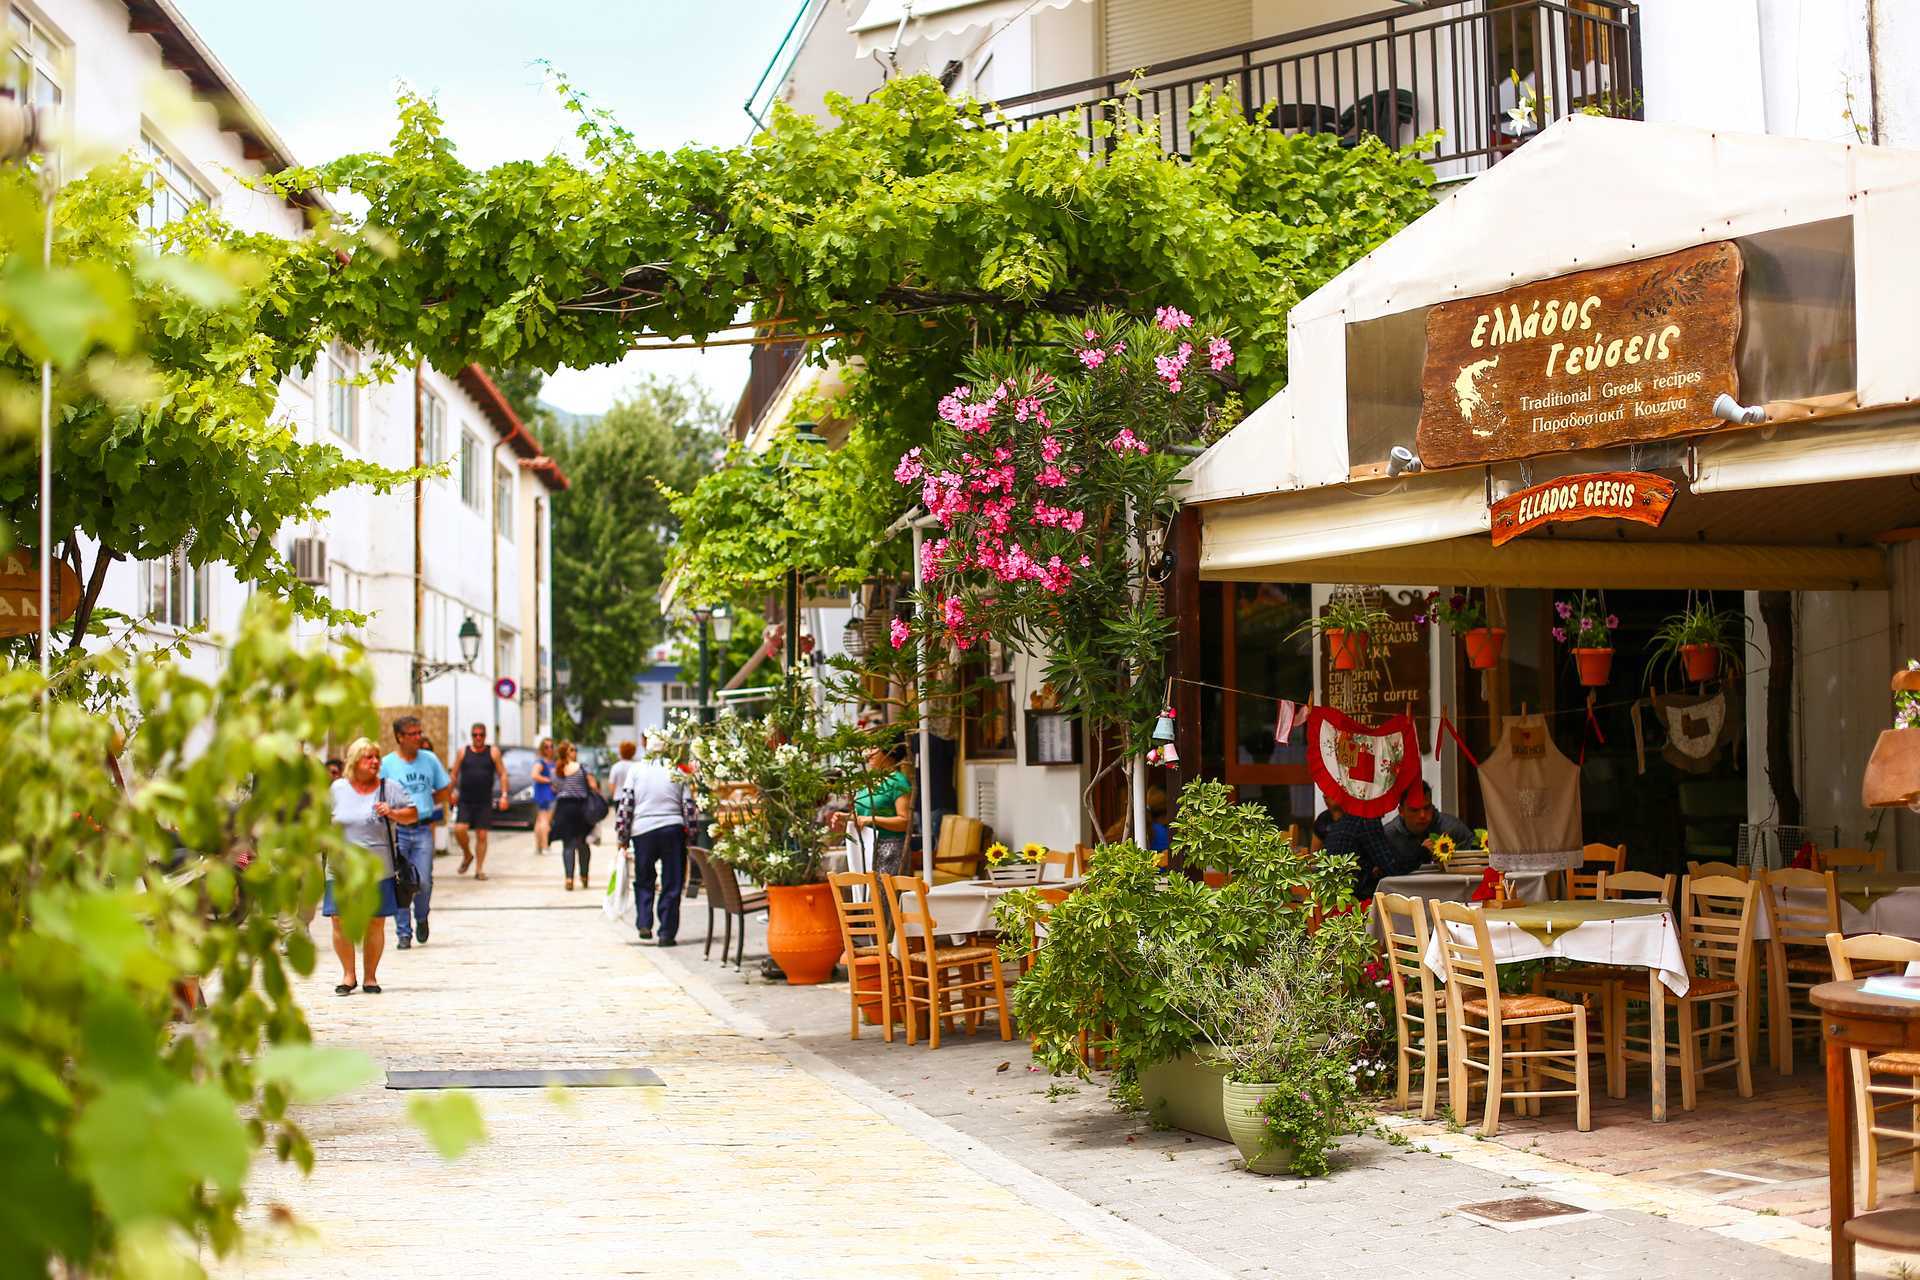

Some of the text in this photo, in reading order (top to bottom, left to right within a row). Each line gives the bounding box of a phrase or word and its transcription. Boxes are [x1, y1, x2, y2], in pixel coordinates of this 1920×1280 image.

[1470, 296, 1602, 349] Ελλάδος
[1545, 325, 1681, 378] Γεύσεις
[1520, 371, 1702, 412] Traditional Greek recipes
[1532, 404, 1625, 433] Παραδοσιακή
[1518, 481, 1636, 525] ELLADOS GEFSIS
[1329, 683, 1368, 695] DESRTS
[1384, 690, 1420, 701] COFFEE
